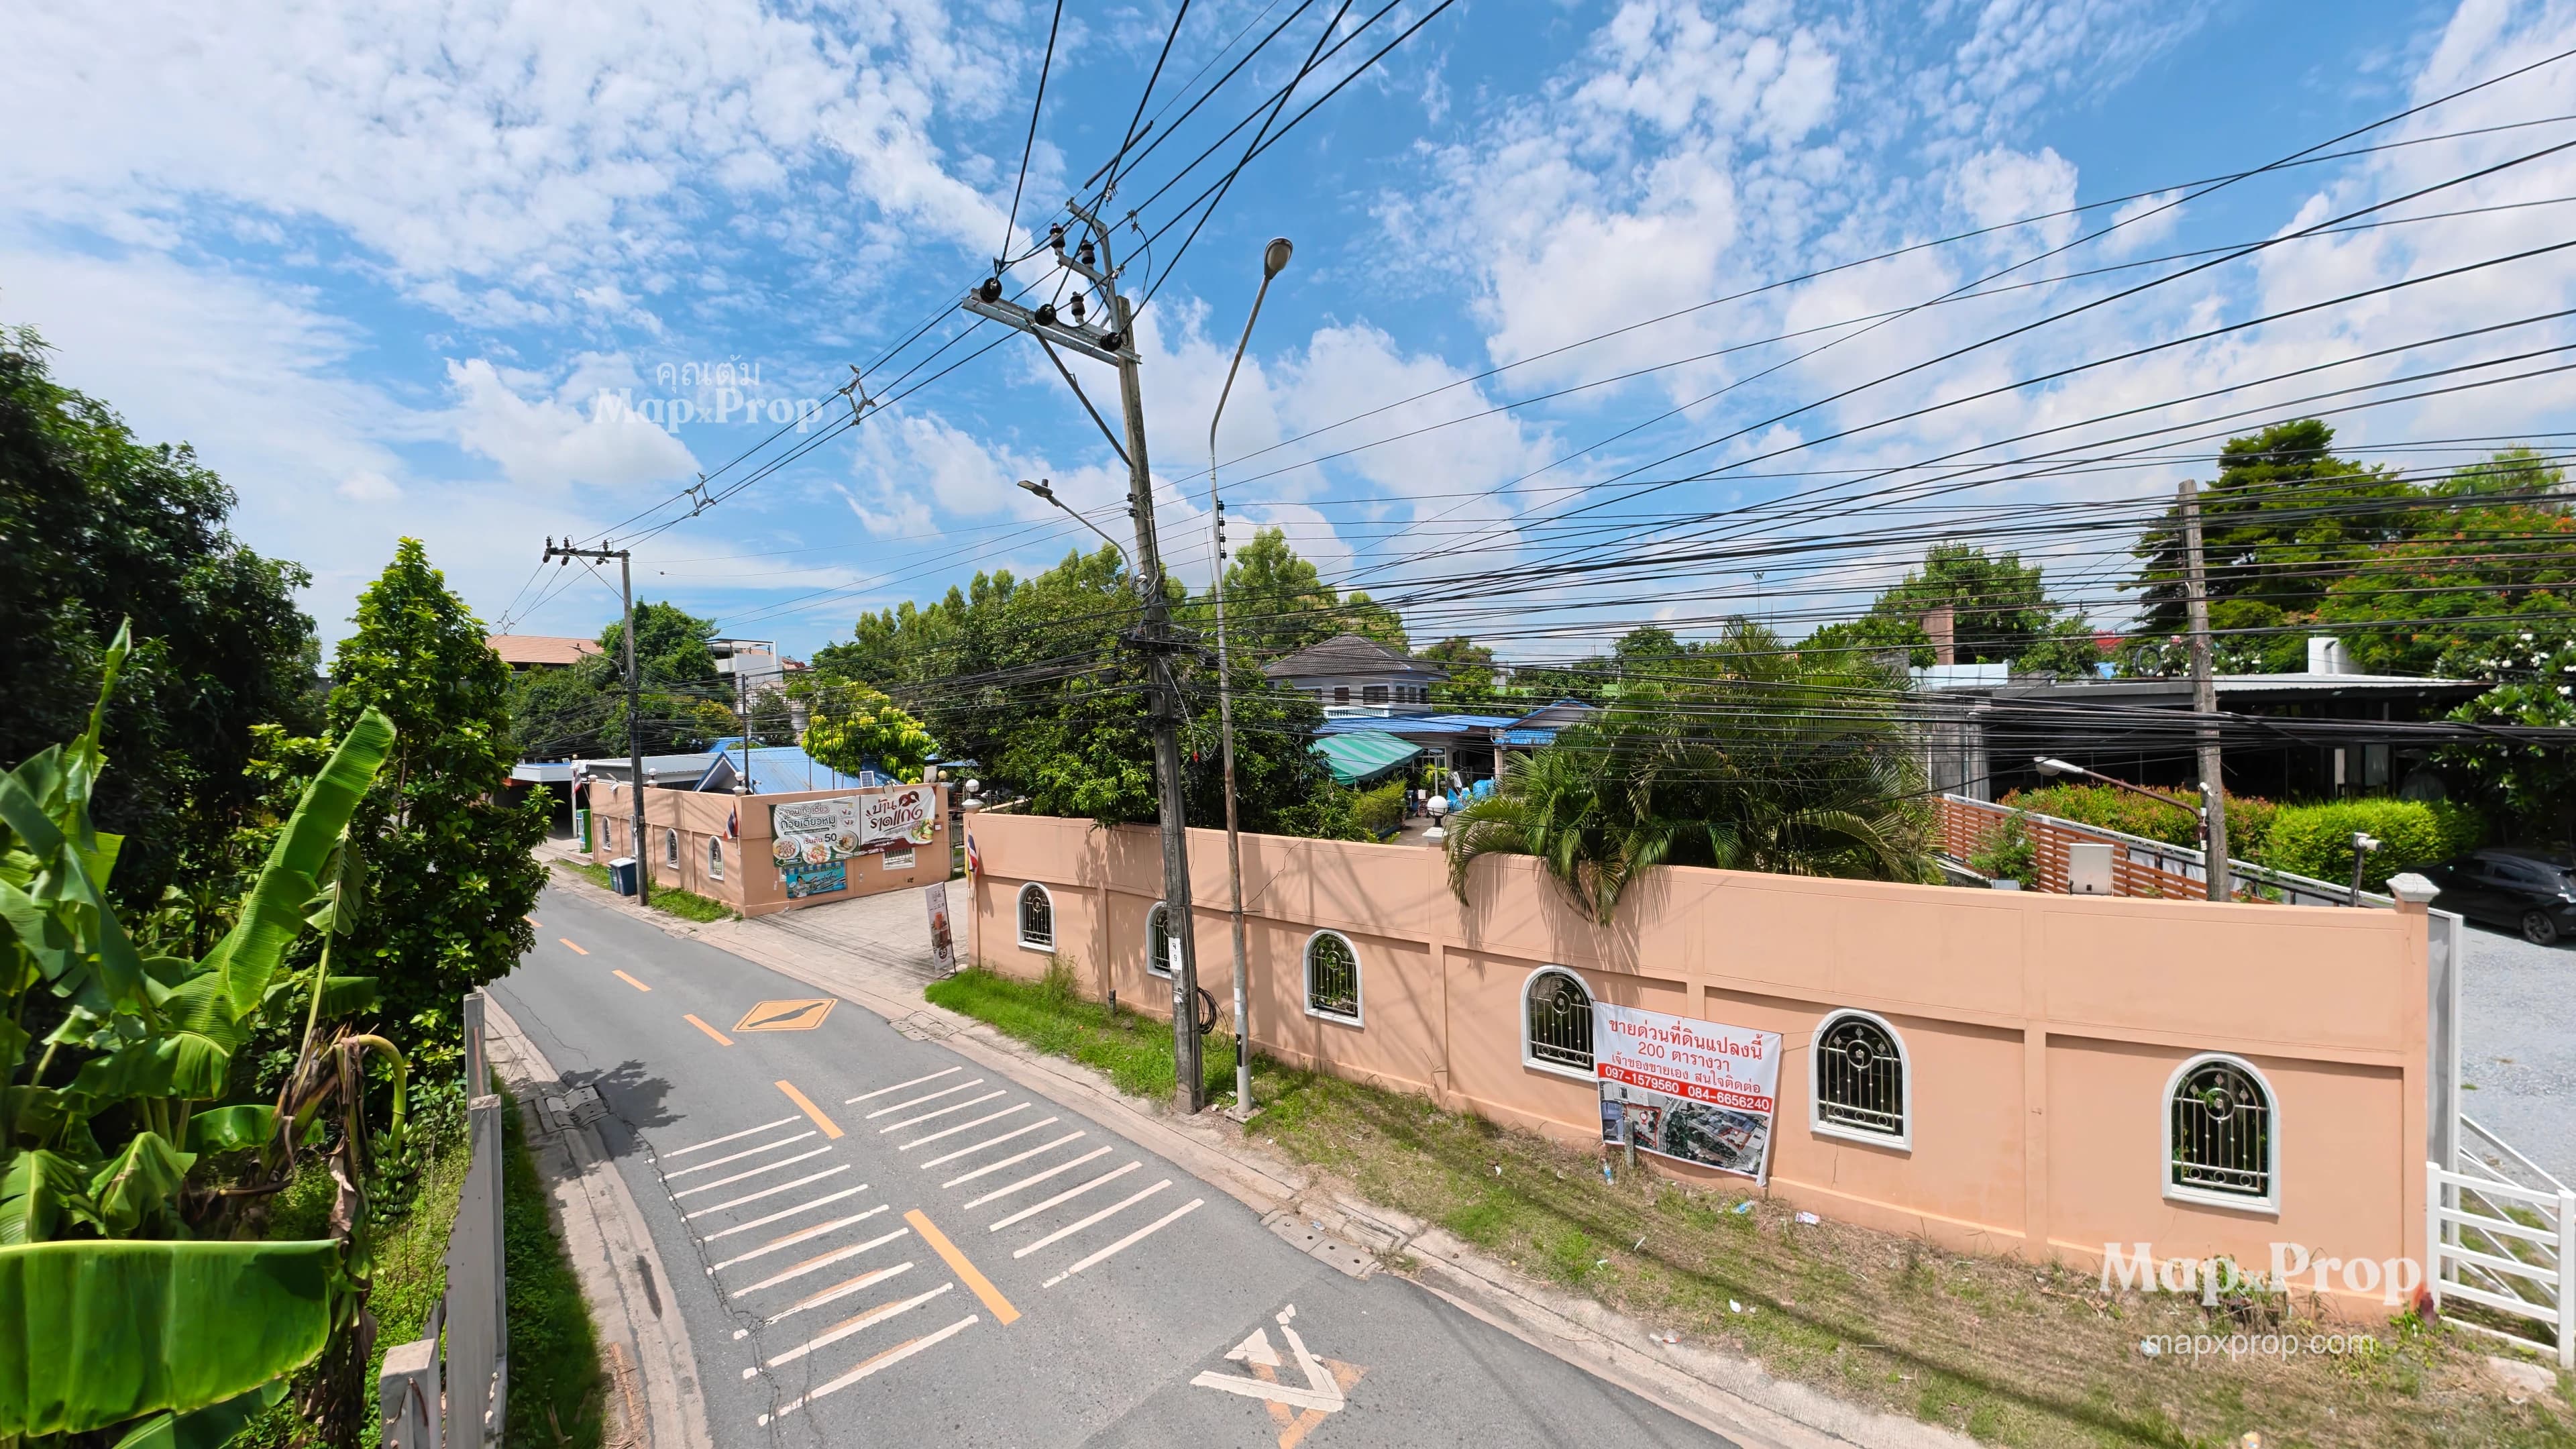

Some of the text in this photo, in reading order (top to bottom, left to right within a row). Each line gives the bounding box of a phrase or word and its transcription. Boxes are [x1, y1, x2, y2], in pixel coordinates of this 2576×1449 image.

[873, 798, 897, 814] บ้าน
[824, 833, 837, 843] 50
[1609, 1019, 1763, 1061] ขายด่วนที่ดินแปลงนี้
[1638, 1041, 1730, 1072] 200 ตารางวา
[1605, 1065, 1770, 1111] 097-1579560 084-6656240
[1611, 1051, 1761, 1094] เจ้าของขายเอง สนใจติดต่อ
